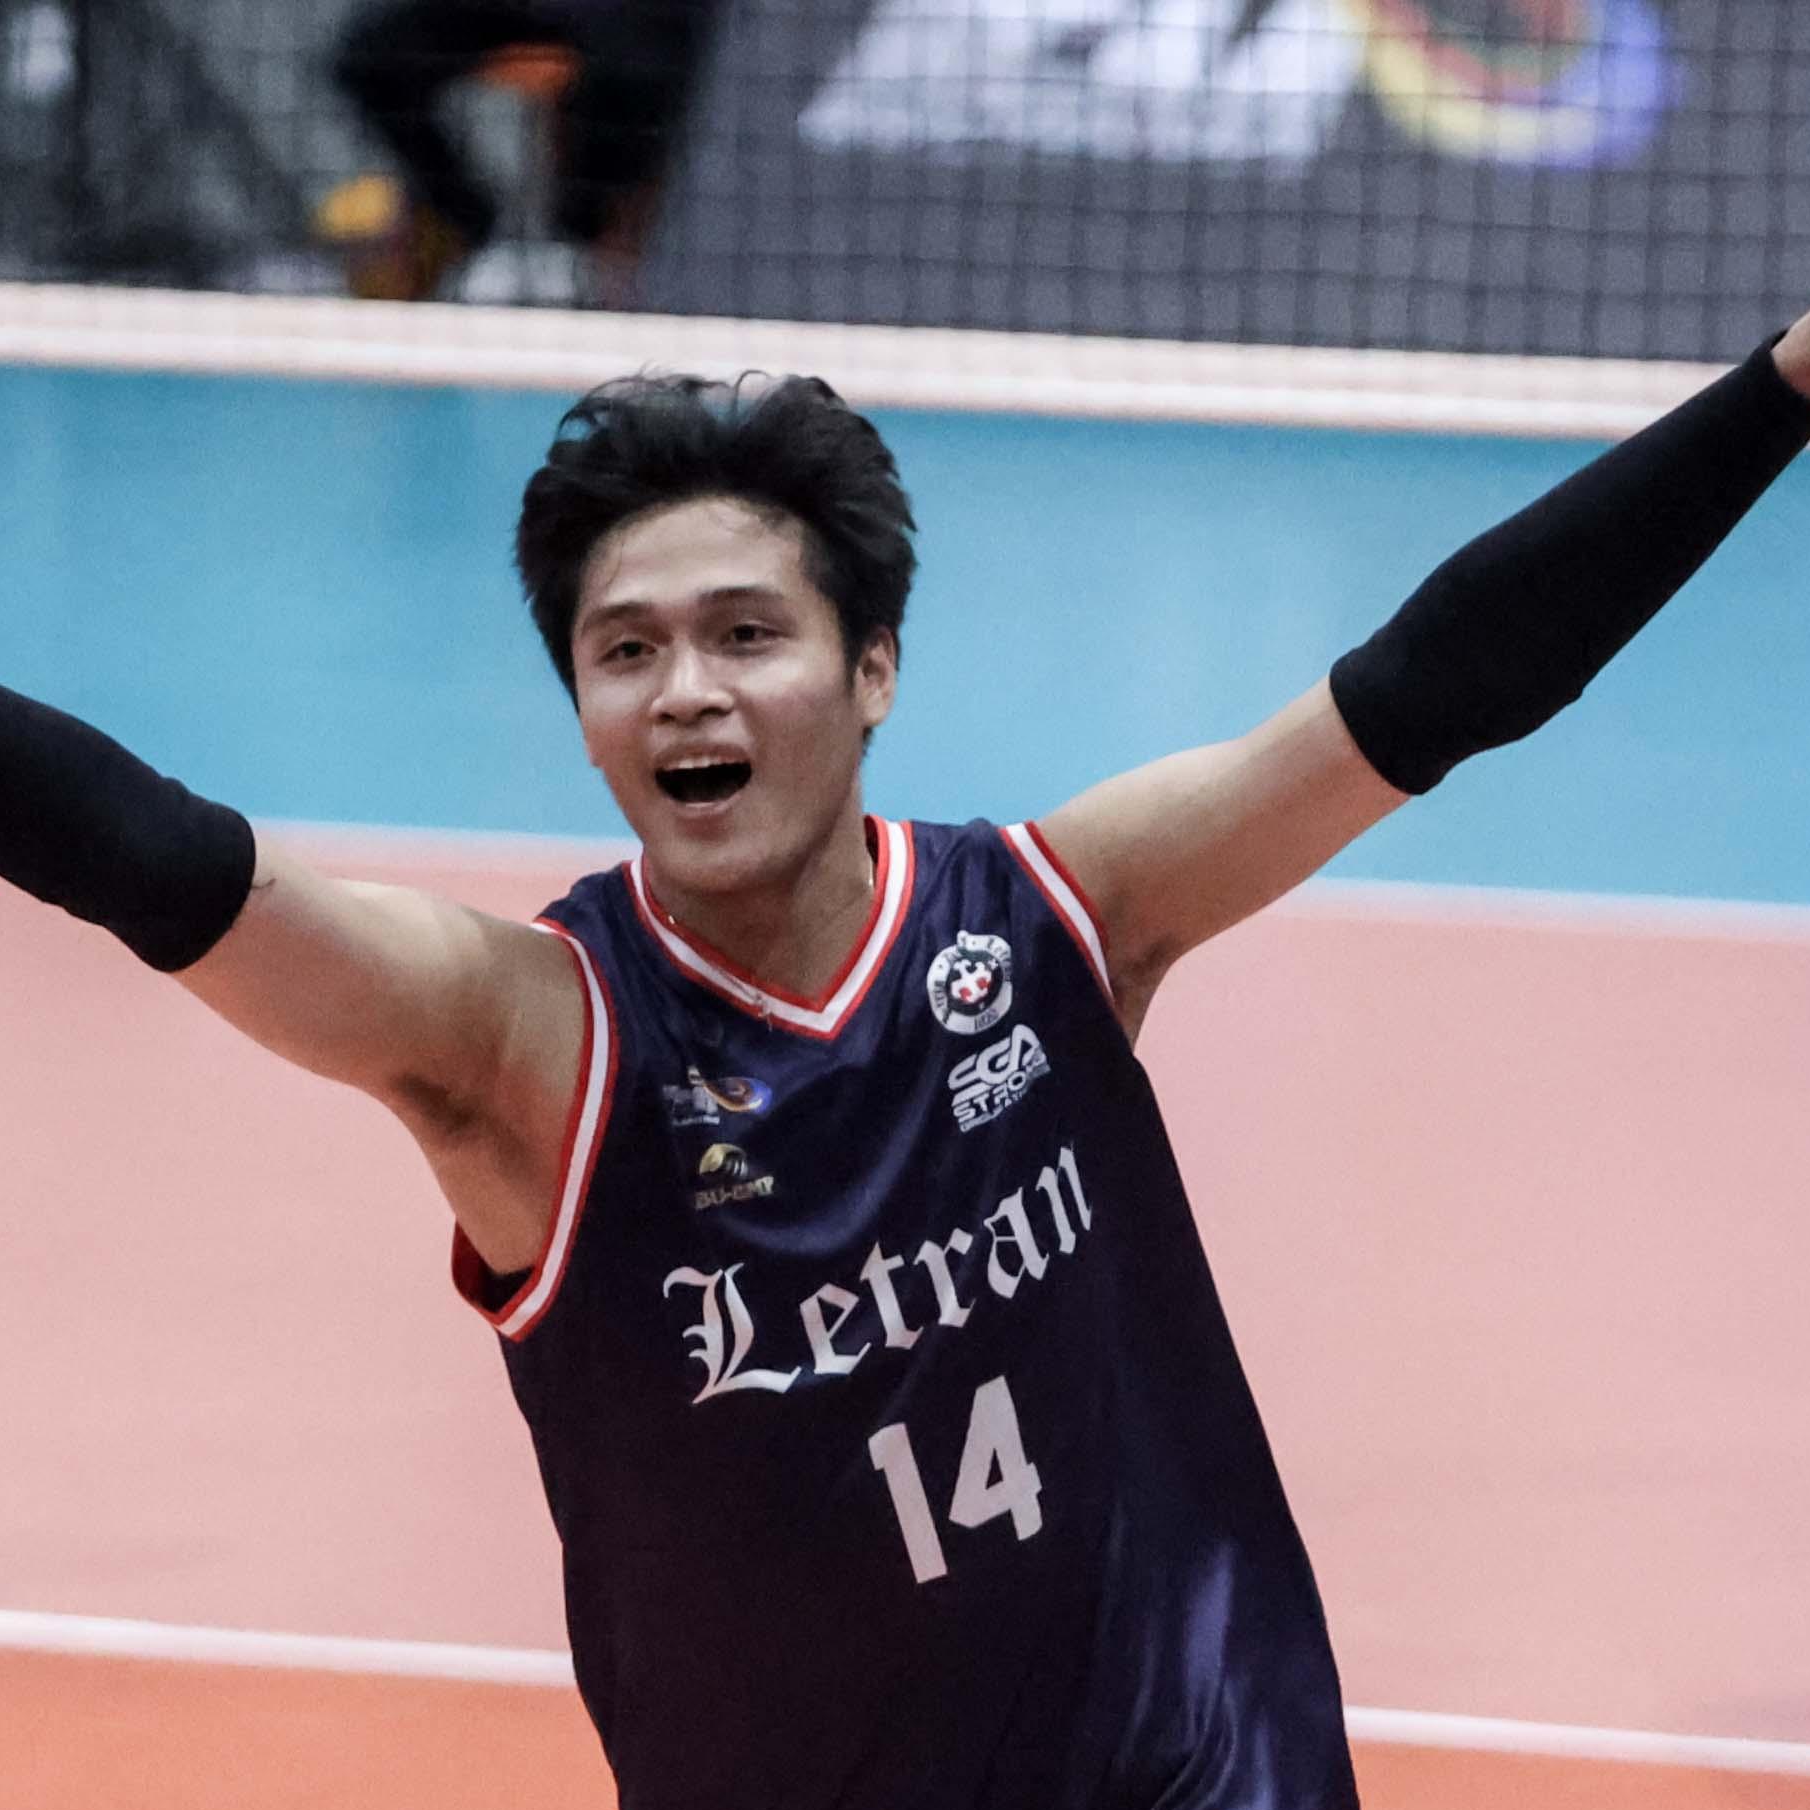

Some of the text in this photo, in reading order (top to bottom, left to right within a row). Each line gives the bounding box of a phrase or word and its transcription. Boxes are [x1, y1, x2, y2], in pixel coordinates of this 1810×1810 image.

[948, 1024, 1040, 1107] SGA
[662, 1140, 1094, 1405] Letran
[867, 1374, 1043, 1584] 14
